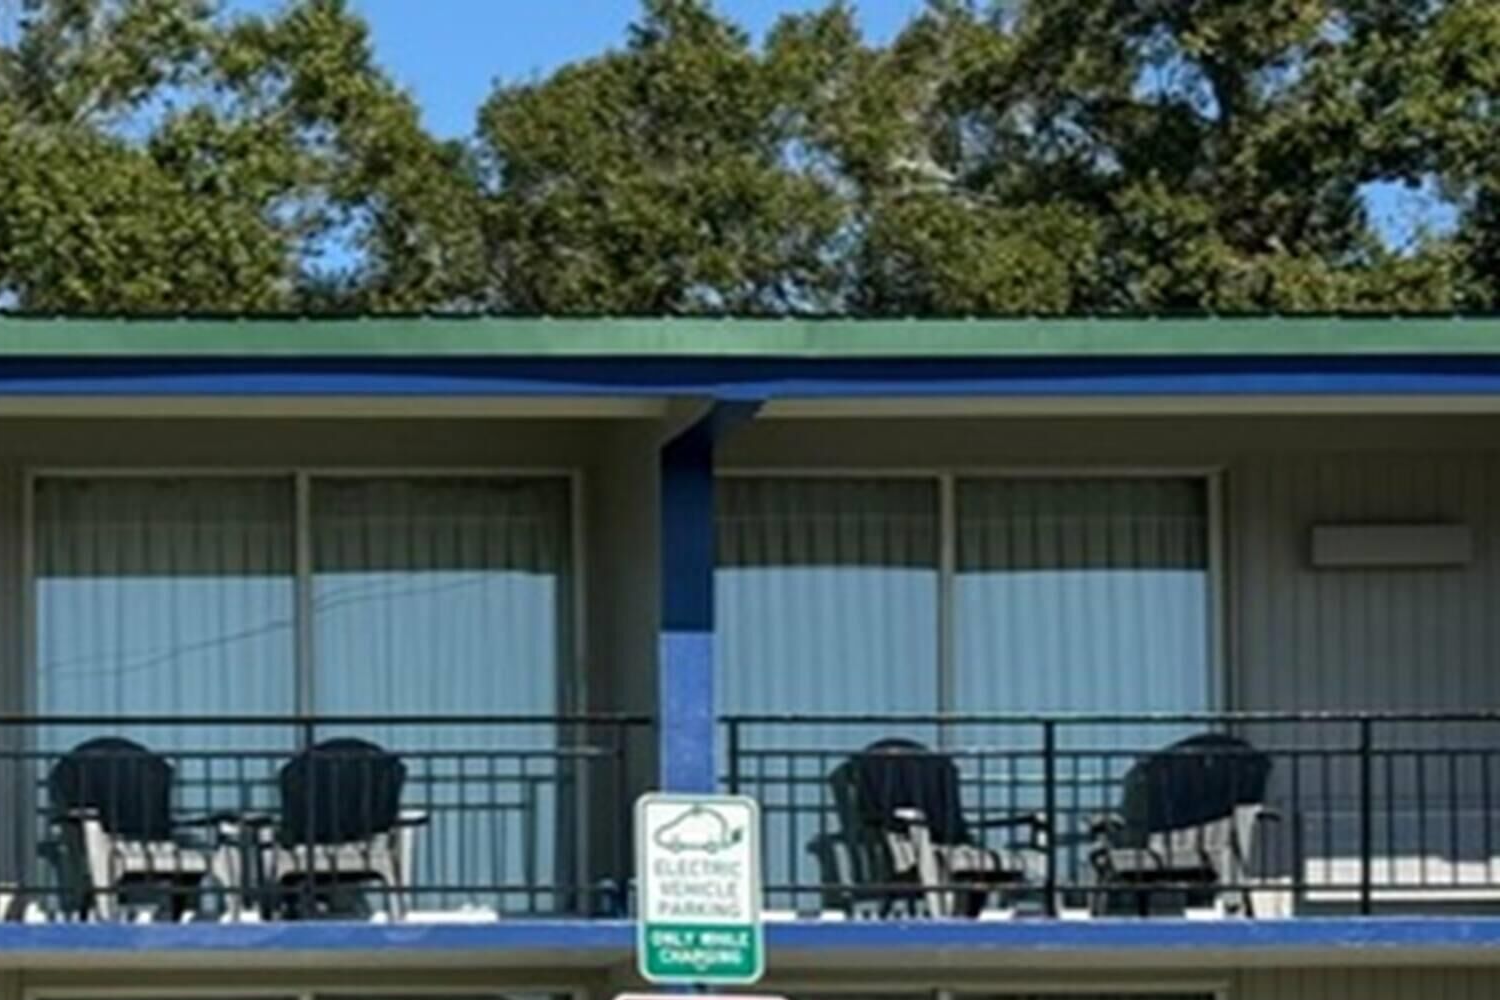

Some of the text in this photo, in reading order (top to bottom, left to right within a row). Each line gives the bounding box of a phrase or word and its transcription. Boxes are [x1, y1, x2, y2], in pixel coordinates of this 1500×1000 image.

[654, 859, 742, 876] ELECTRIC
[660, 882, 738, 897] VEHICLE
[659, 901, 741, 917] PARKING
